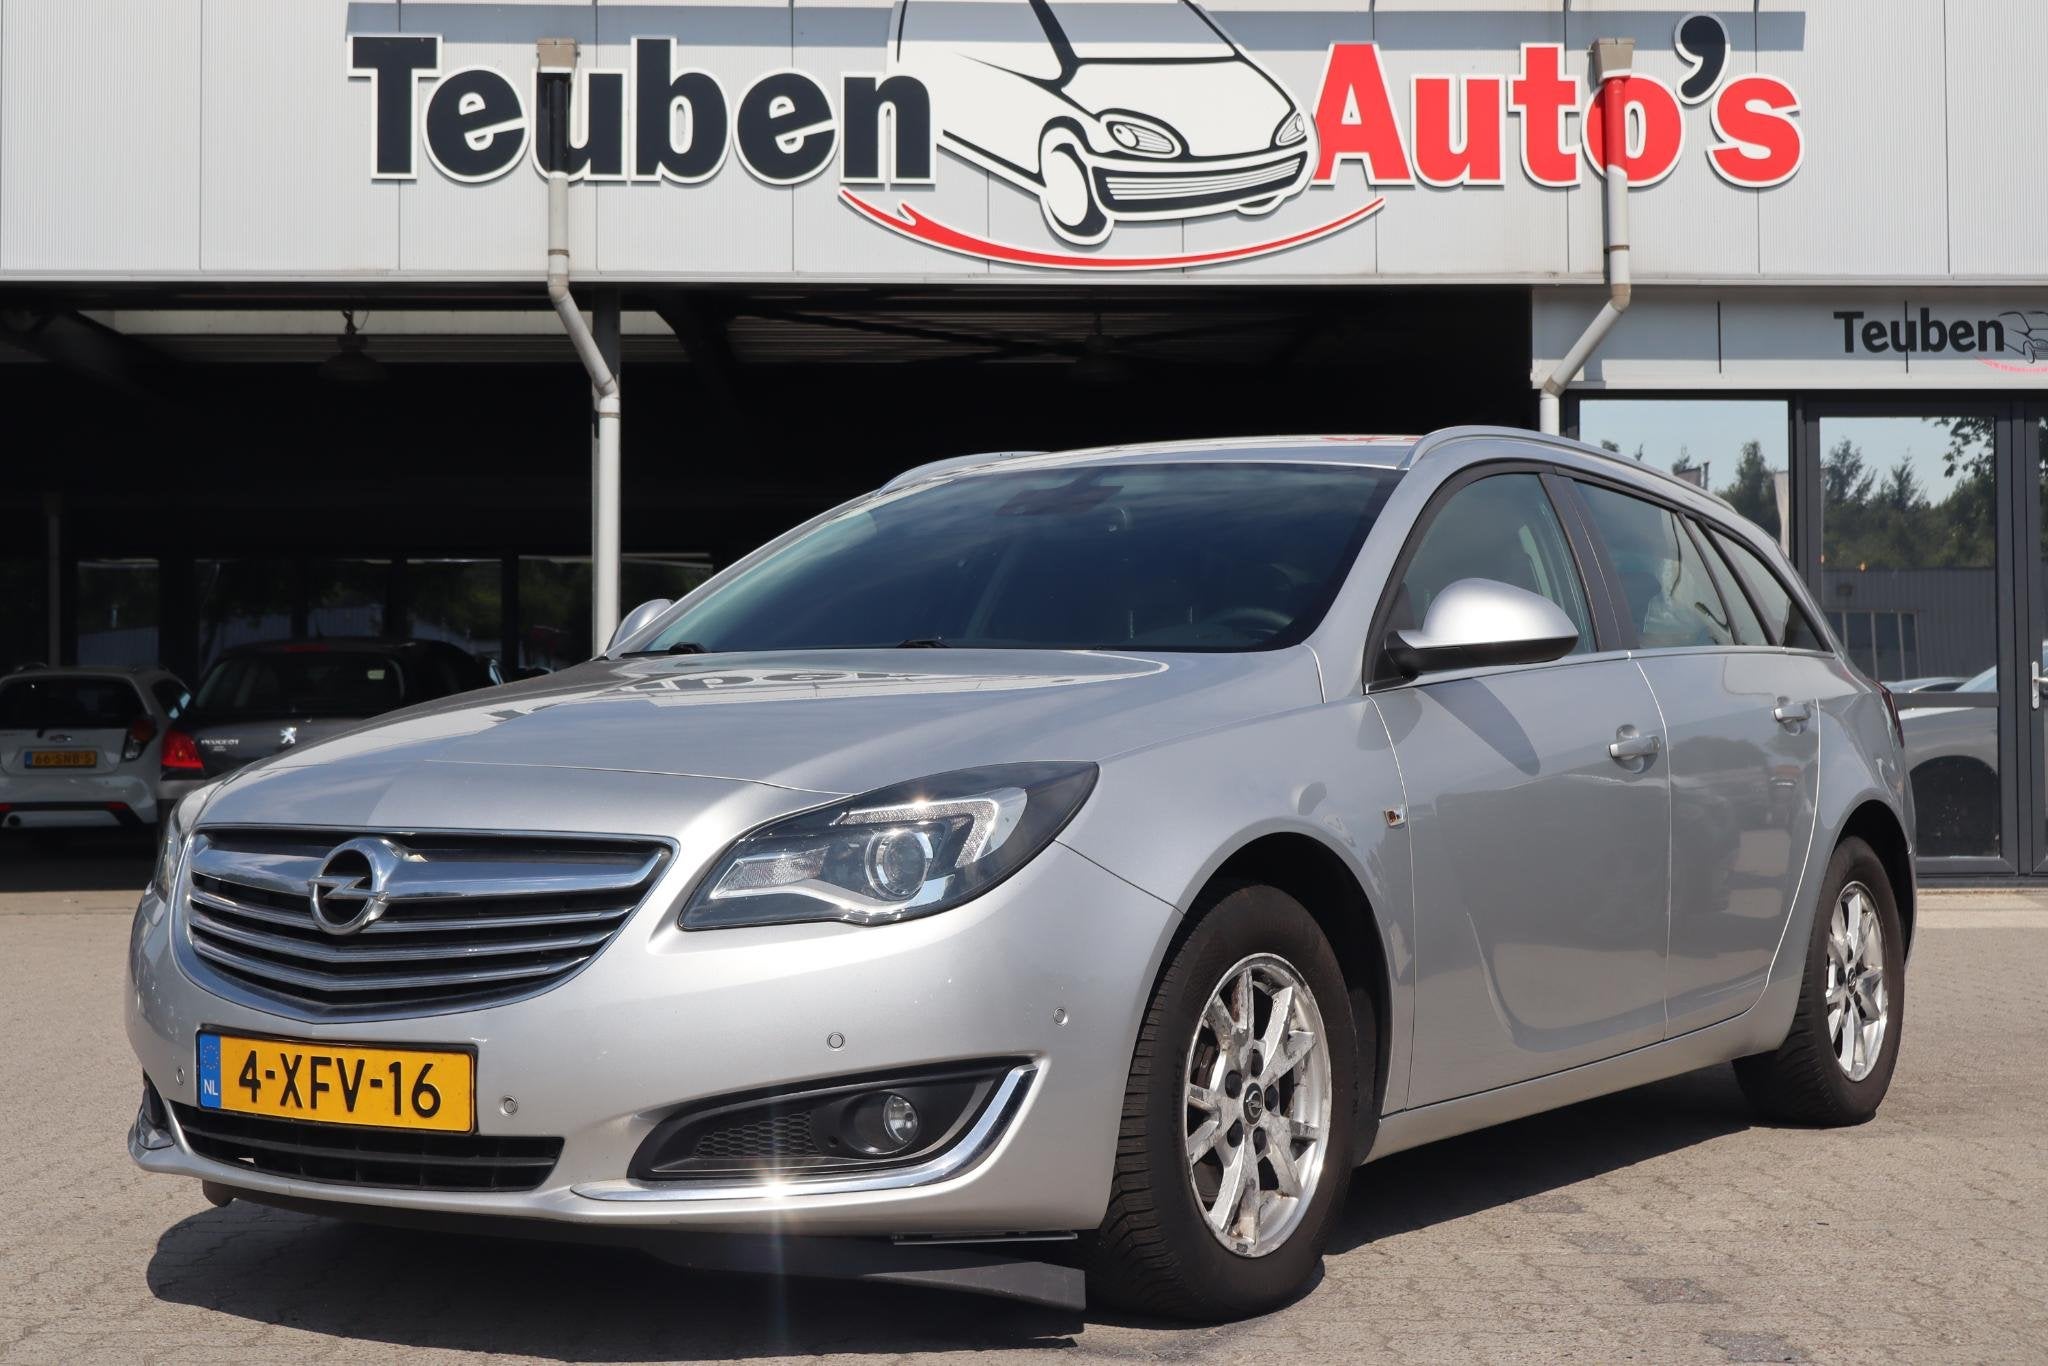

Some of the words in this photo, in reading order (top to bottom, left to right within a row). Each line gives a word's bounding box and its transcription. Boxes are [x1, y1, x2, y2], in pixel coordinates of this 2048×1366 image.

[350, 35, 934, 184] Teuben
[1311, 14, 1803, 186] Auto's
[1833, 307, 2005, 353] Teuben
[203, 1079, 219, 1096] NL
[238, 1050, 442, 1118] 4-XFV-16
